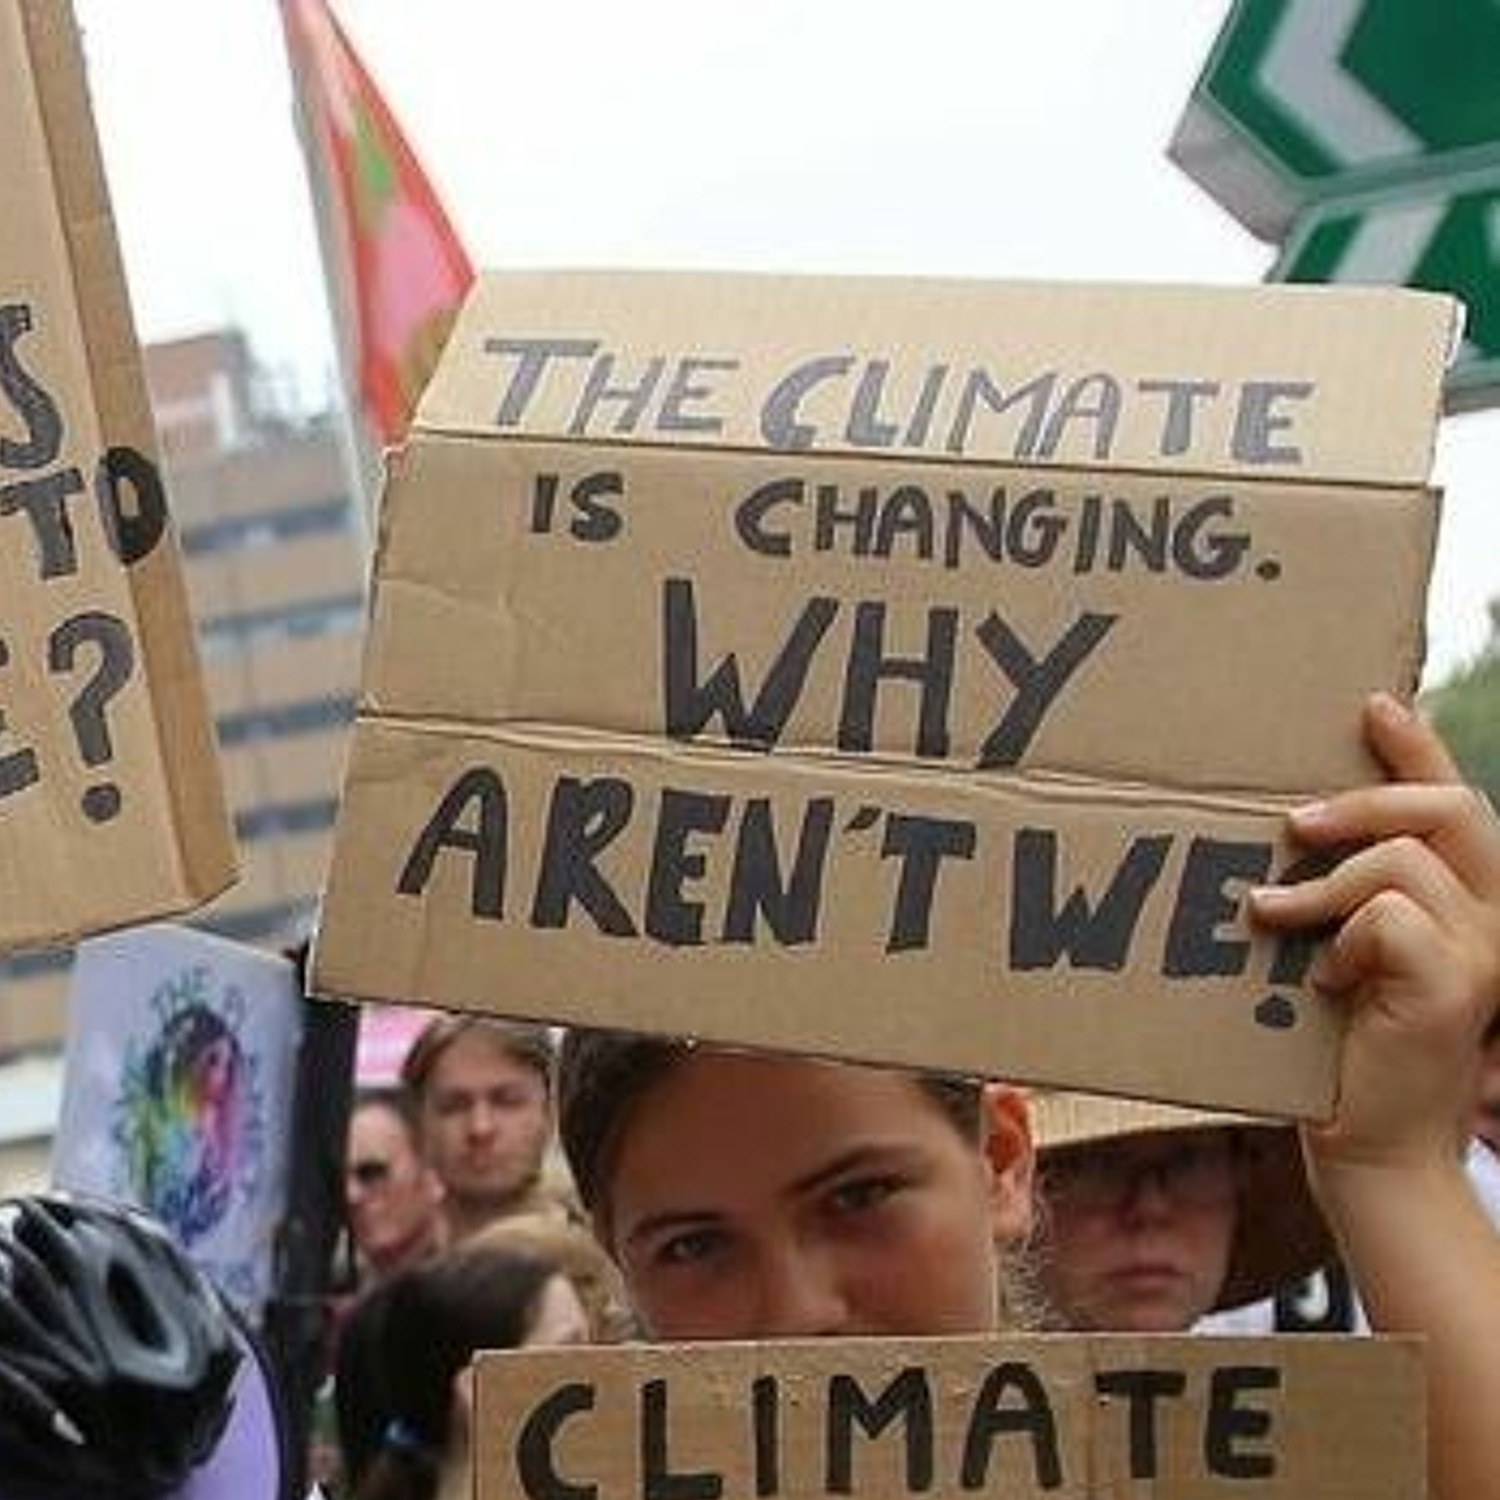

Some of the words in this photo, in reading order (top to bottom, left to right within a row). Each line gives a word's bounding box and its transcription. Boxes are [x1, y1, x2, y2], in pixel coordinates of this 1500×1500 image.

[484, 337, 740, 436] THE
[759, 355, 1317, 467] CLIMATE
[530, 472, 625, 542] IS
[734, 477, 1281, 581] CHANGING.
[662, 577, 1119, 770] WHY
[395, 765, 979, 954] AREN'T
